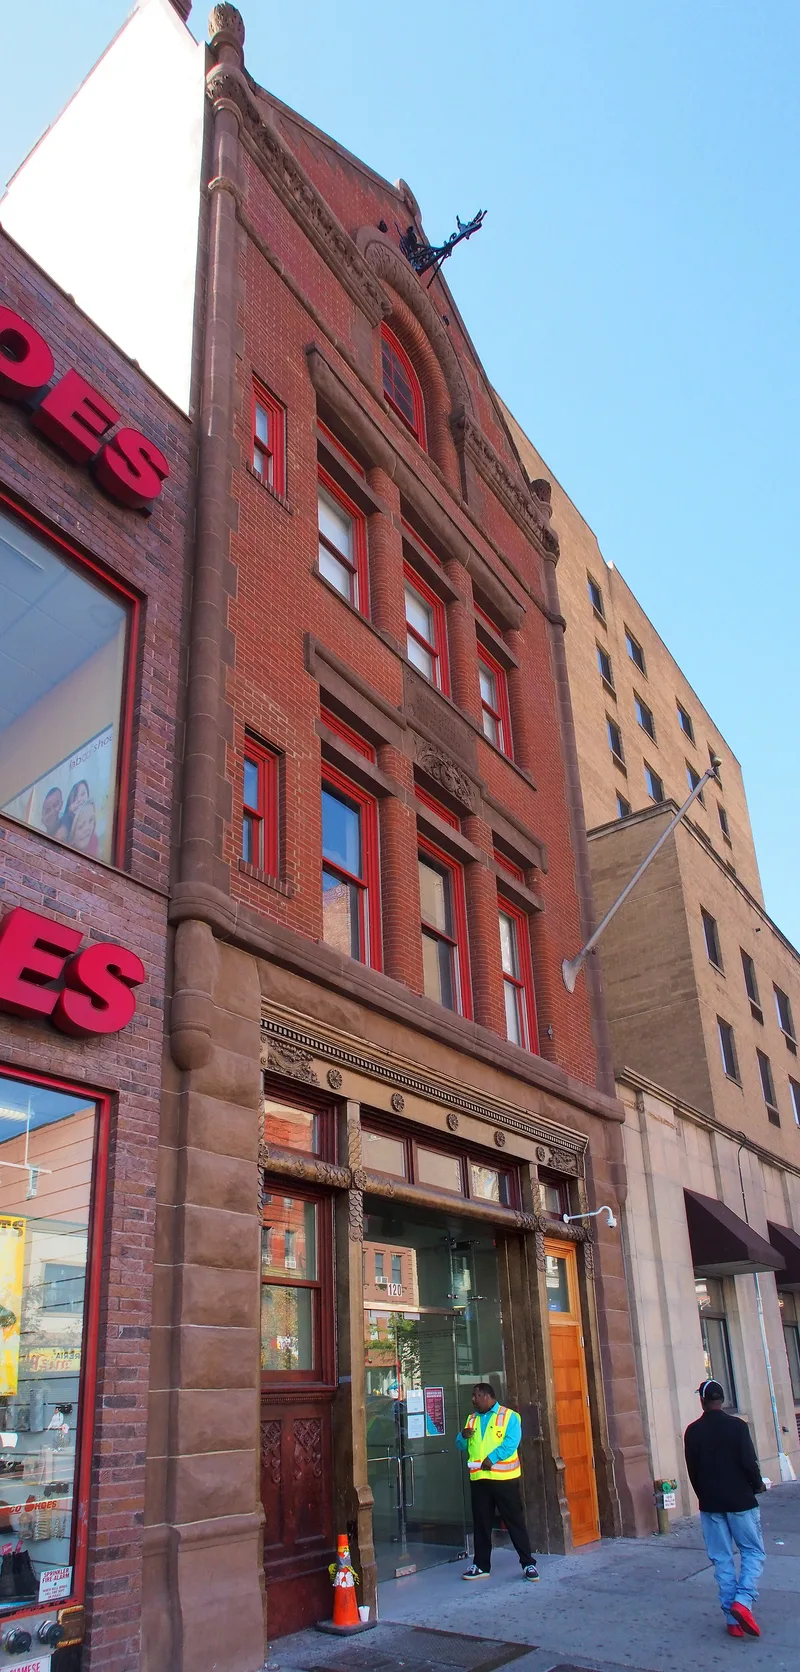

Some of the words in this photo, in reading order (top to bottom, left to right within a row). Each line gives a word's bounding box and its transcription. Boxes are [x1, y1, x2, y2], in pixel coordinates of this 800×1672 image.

[0, 305, 170, 503] OES
[0, 906, 145, 1034] ES
[388, 1283, 402, 1296] 120
[44, 1567, 70, 1578] SPRINKLER
[10, 1661, 40, 1672] MESE
